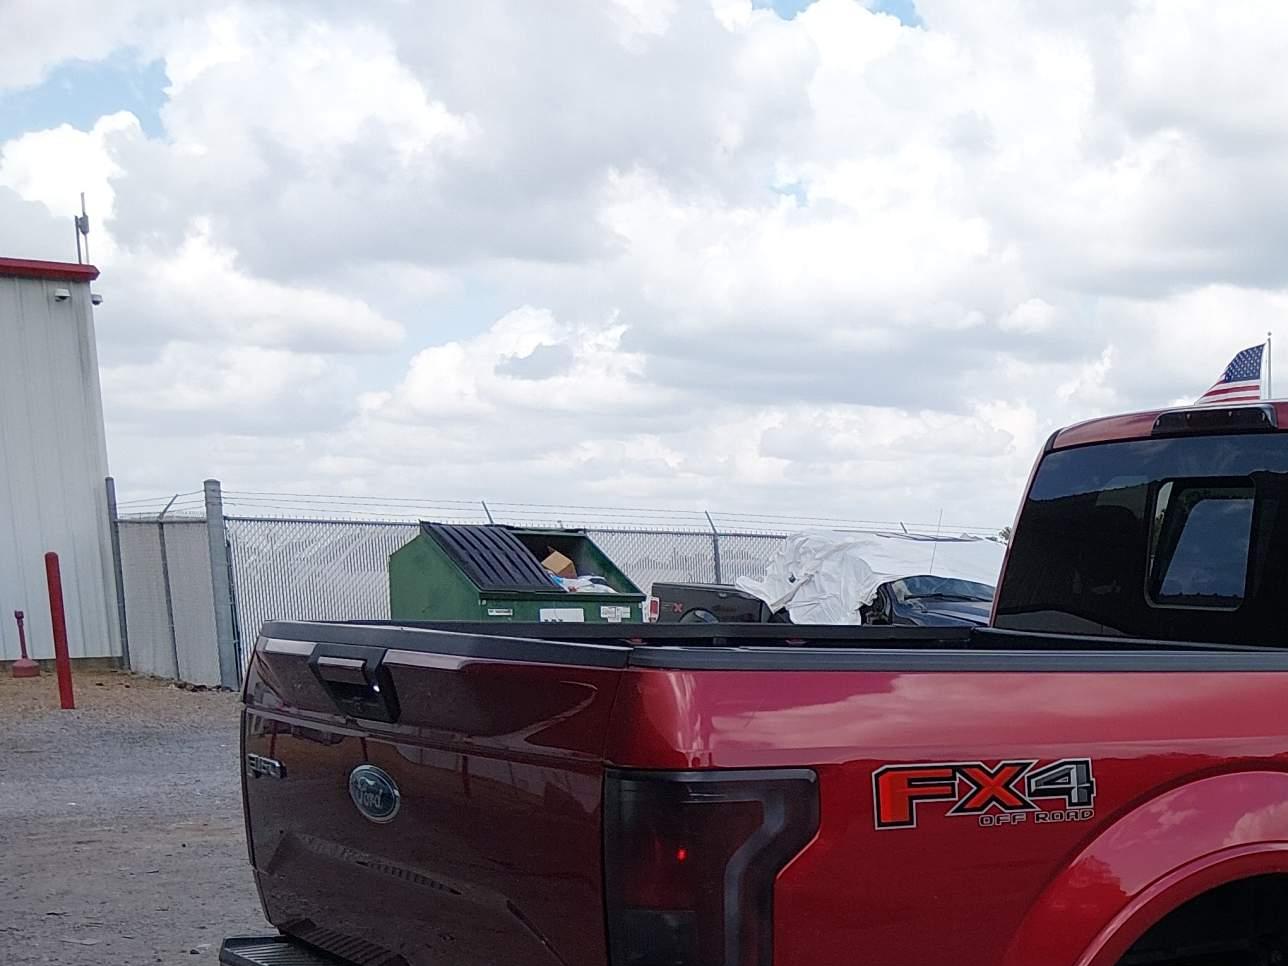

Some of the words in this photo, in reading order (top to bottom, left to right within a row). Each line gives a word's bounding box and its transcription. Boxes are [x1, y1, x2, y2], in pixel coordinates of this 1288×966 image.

[872, 758, 1096, 830] FX4
[979, 813, 1027, 827] OFF
[1034, 808, 1095, 823] ROAD
